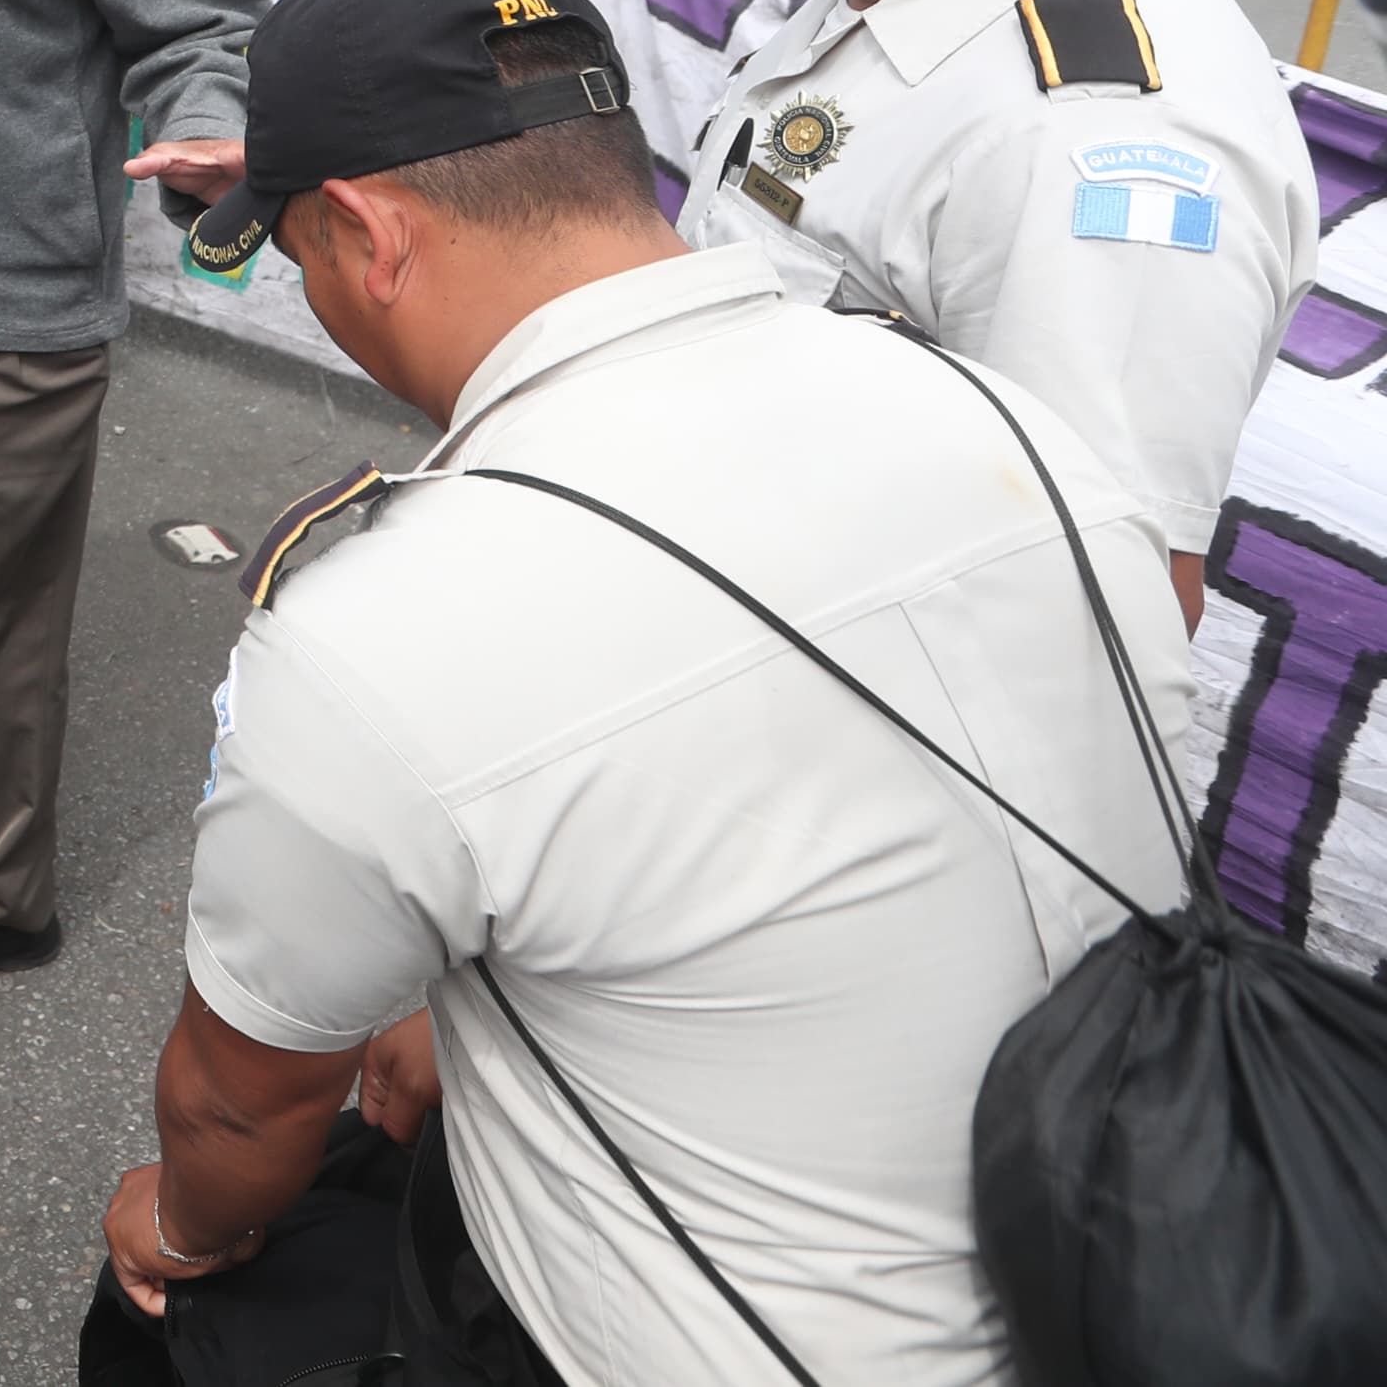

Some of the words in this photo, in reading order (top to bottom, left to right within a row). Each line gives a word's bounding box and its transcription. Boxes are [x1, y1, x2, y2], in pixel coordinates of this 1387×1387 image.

[1088, 149, 1206, 177] GUATEMALA
[192, 234, 240, 264] NACIONAL
[239, 219, 263, 250] CIVIL
